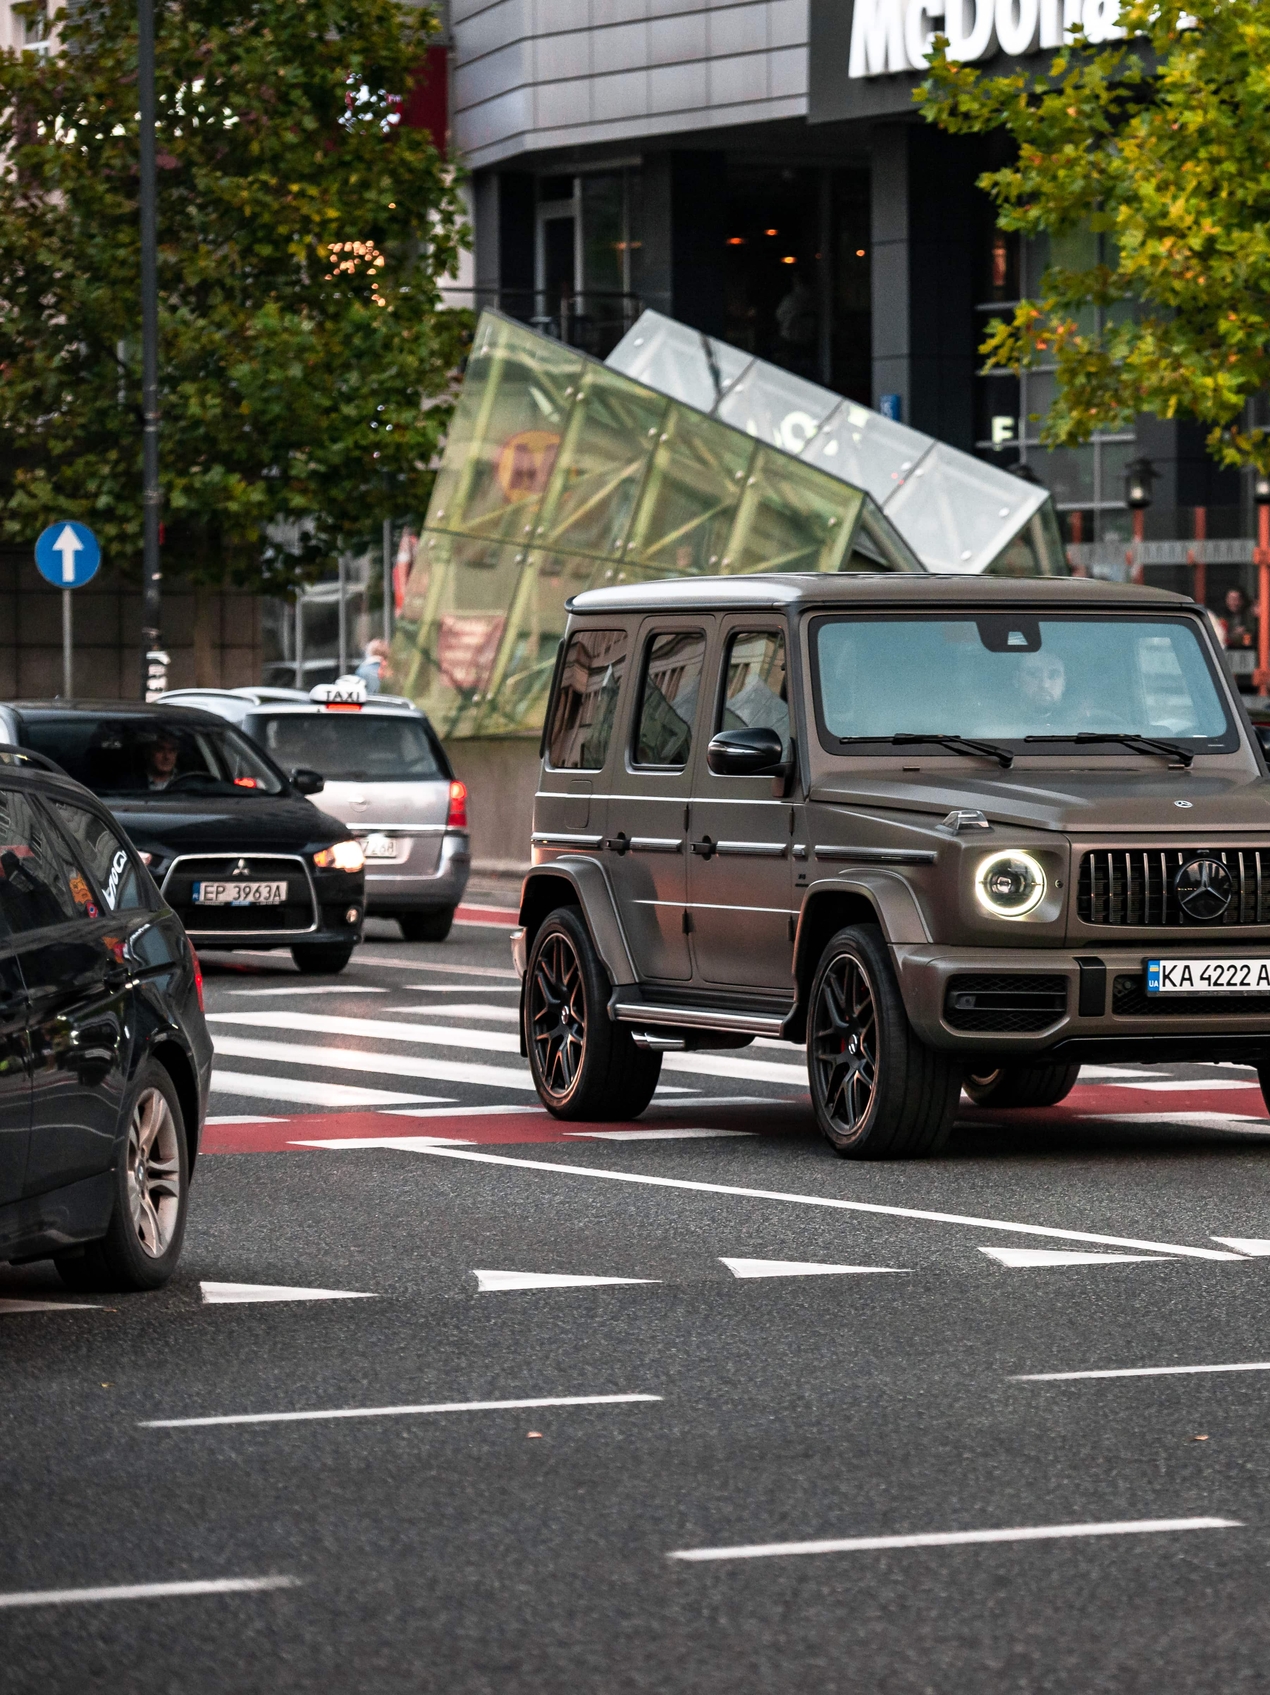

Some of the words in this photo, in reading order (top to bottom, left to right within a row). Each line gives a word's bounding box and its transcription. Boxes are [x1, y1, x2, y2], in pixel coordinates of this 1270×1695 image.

[325, 690, 360, 702] TAXI
[203, 885, 225, 901] EP
[232, 885, 281, 901] 3963A
[1162, 965, 1194, 987] KA
[1199, 965, 1251, 987] 4222
[1149, 980, 1159, 988] UA
